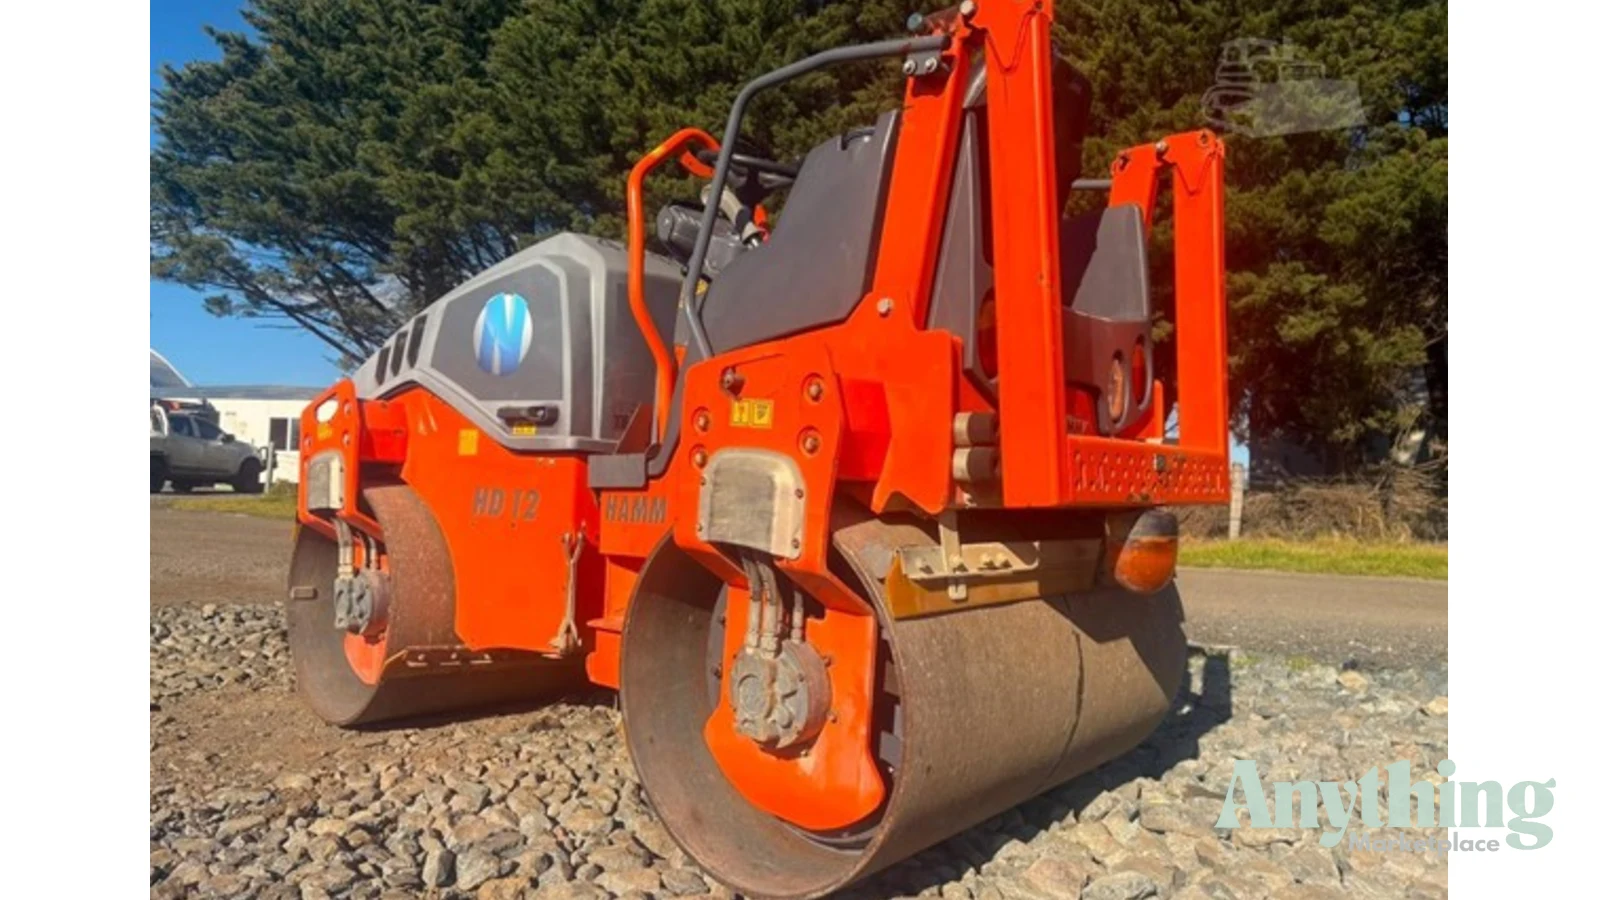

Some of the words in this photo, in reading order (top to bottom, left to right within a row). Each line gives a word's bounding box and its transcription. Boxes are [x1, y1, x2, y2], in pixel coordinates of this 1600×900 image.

[472, 486, 506, 517] HD
[512, 488, 541, 521] 12
[605, 494, 667, 524] HAMM
